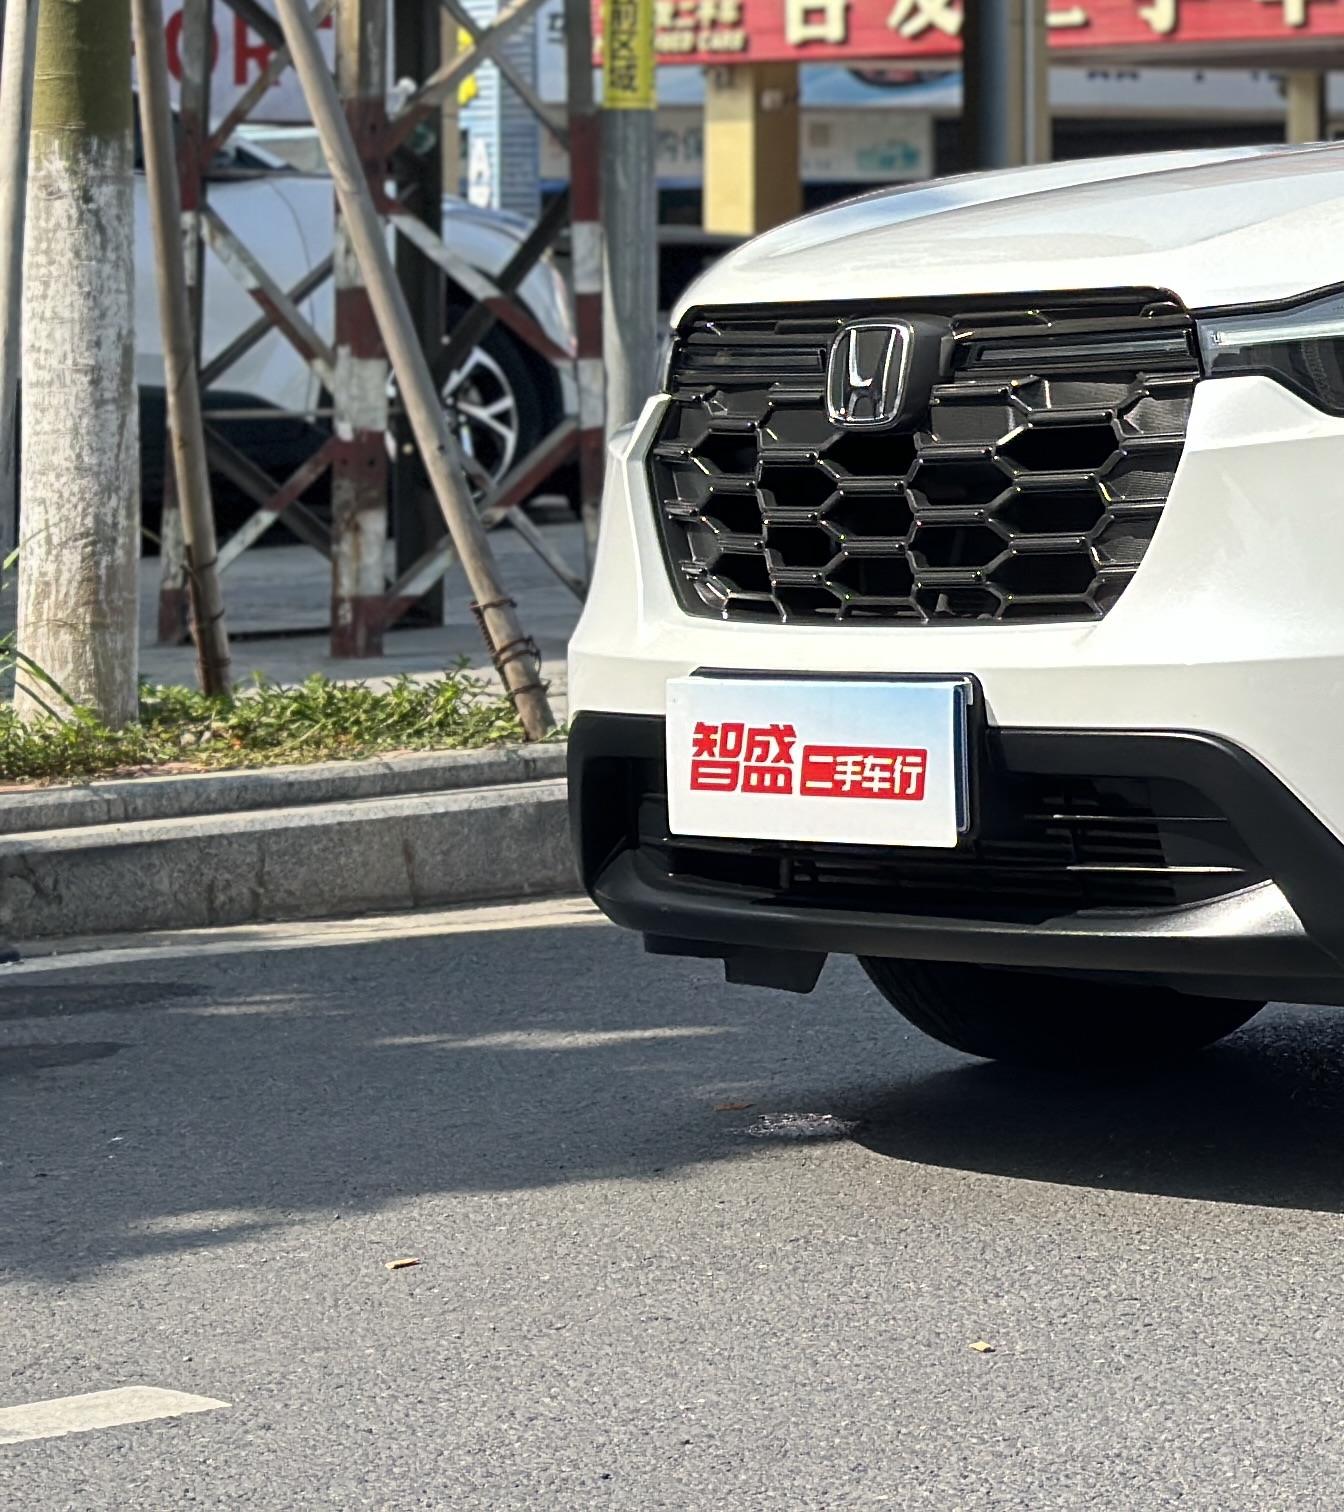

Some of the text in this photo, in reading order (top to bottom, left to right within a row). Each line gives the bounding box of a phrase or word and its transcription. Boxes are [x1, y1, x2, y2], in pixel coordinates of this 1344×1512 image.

[690, 722, 923, 795] 智盛 二手车行
